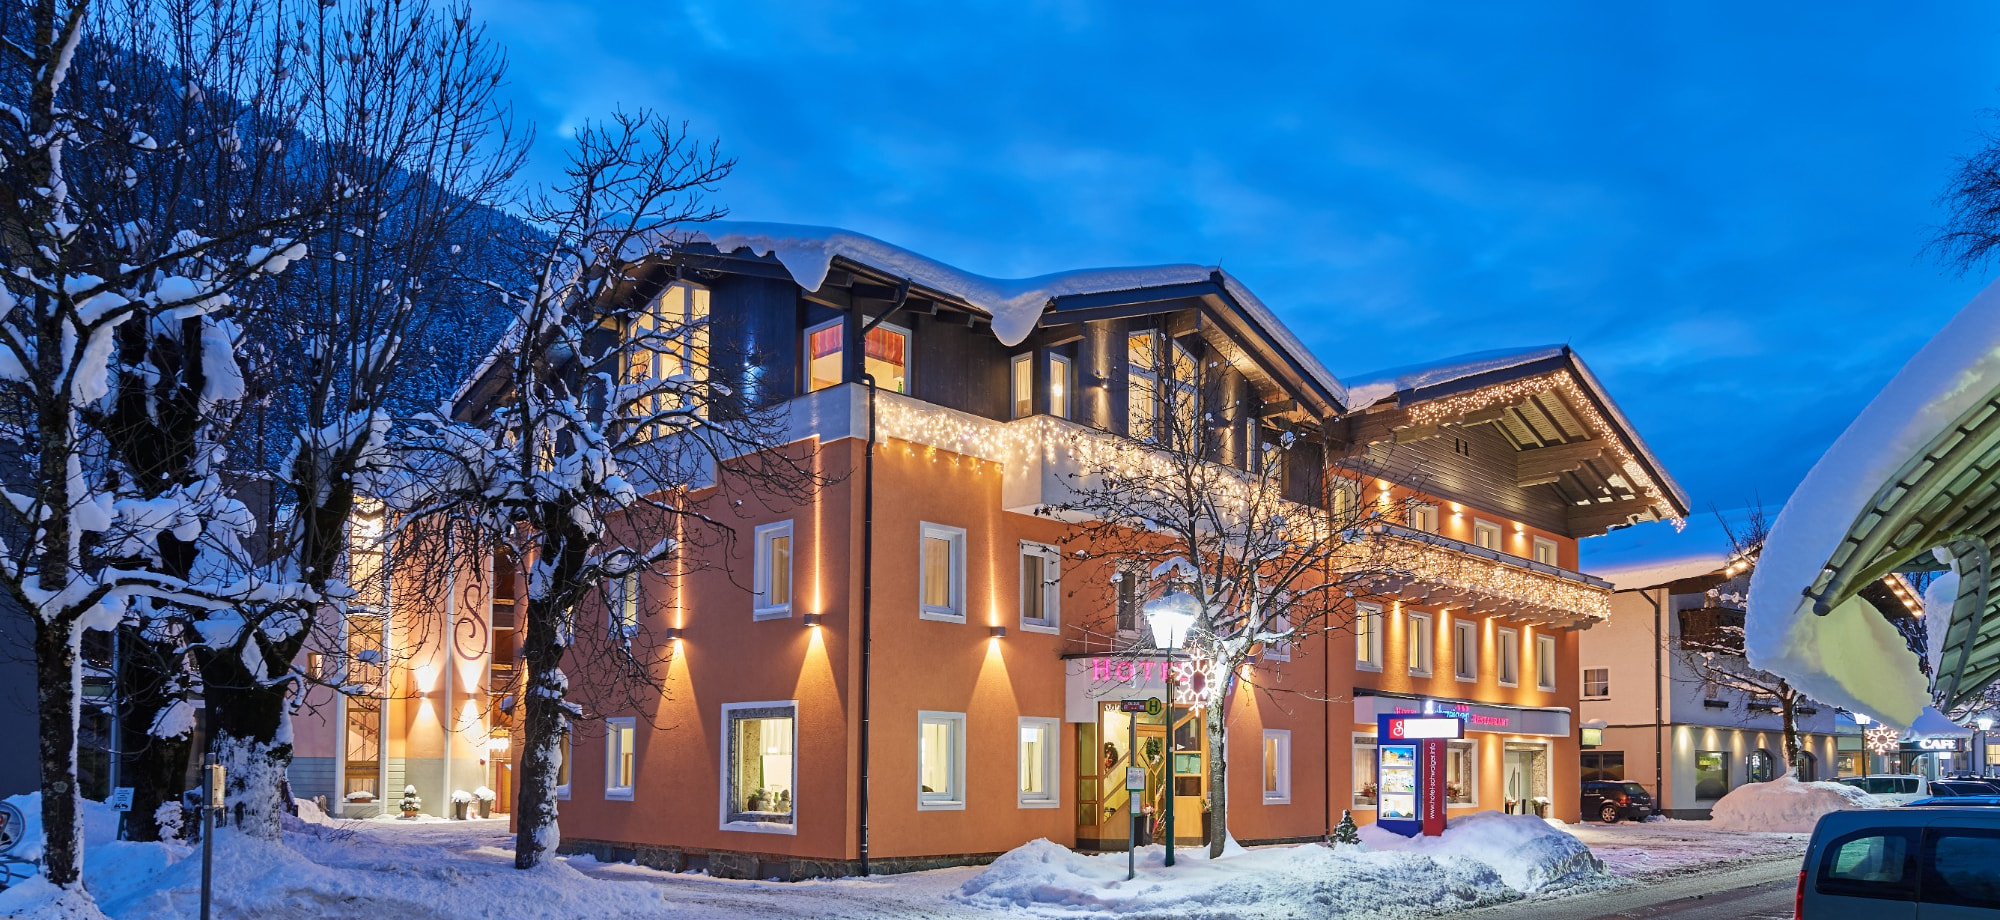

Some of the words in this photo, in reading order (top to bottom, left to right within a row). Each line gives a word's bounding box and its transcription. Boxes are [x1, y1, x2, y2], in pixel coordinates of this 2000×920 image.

[1149, 700, 1158, 711] H
[1472, 714, 1509, 727] RESTAURANT
[1429, 742, 1437, 819] www.hotel-schwaiger.info
